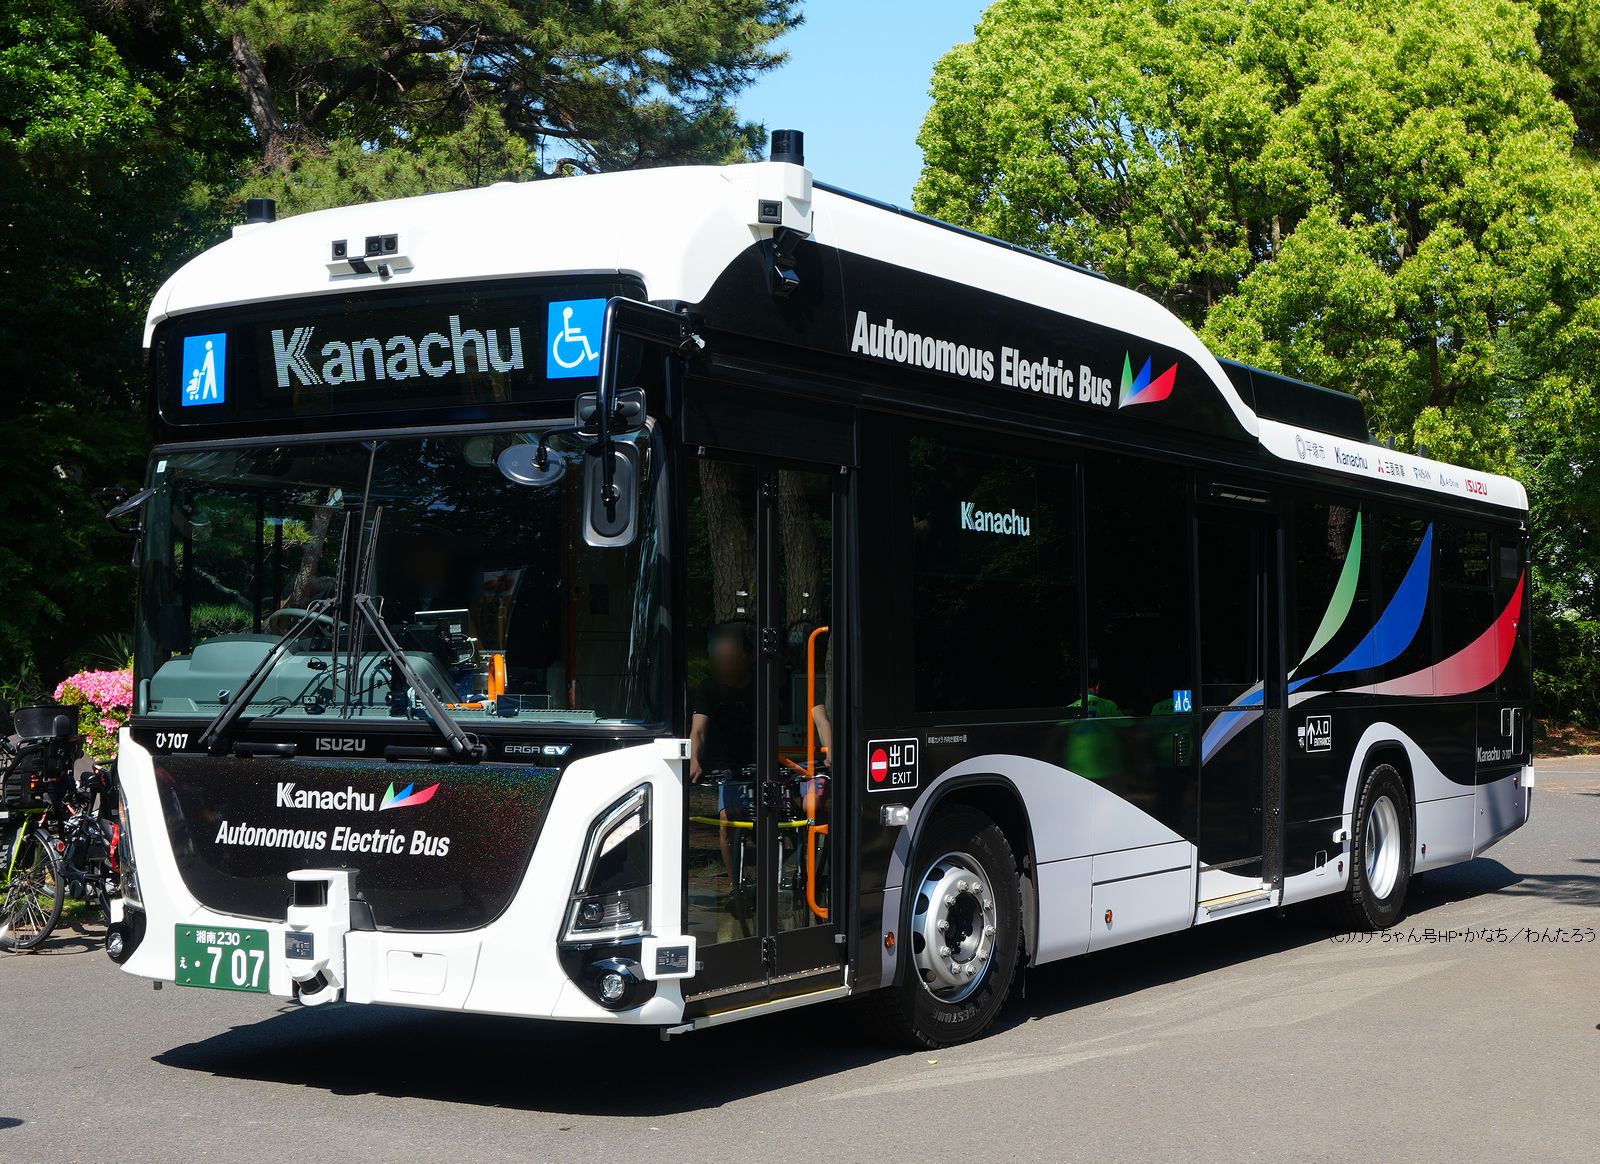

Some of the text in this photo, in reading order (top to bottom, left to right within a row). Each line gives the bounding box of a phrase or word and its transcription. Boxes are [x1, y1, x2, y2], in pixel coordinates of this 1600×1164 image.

[270, 314, 524, 388] Kanachu
[850, 310, 1112, 408] Autonomous Electric Bus
[1334, 446, 1369, 470] Kanachu
[1464, 479, 1488, 496] ISUZU
[960, 500, 1031, 537] Kanachu
[1316, 720, 1329, 736] 入口
[156, 732, 189, 749] ひ707
[315, 737, 366, 751] ISUZU
[504, 745, 567, 755] ERGA EV
[888, 744, 916, 768] 出口
[1476, 746, 1501, 763] Kanachu
[891, 771, 912, 785] EXIT
[276, 782, 375, 812] Kanachu
[215, 820, 451, 858] Autonomous Electric Bus
[179, 956, 188, 969] え
